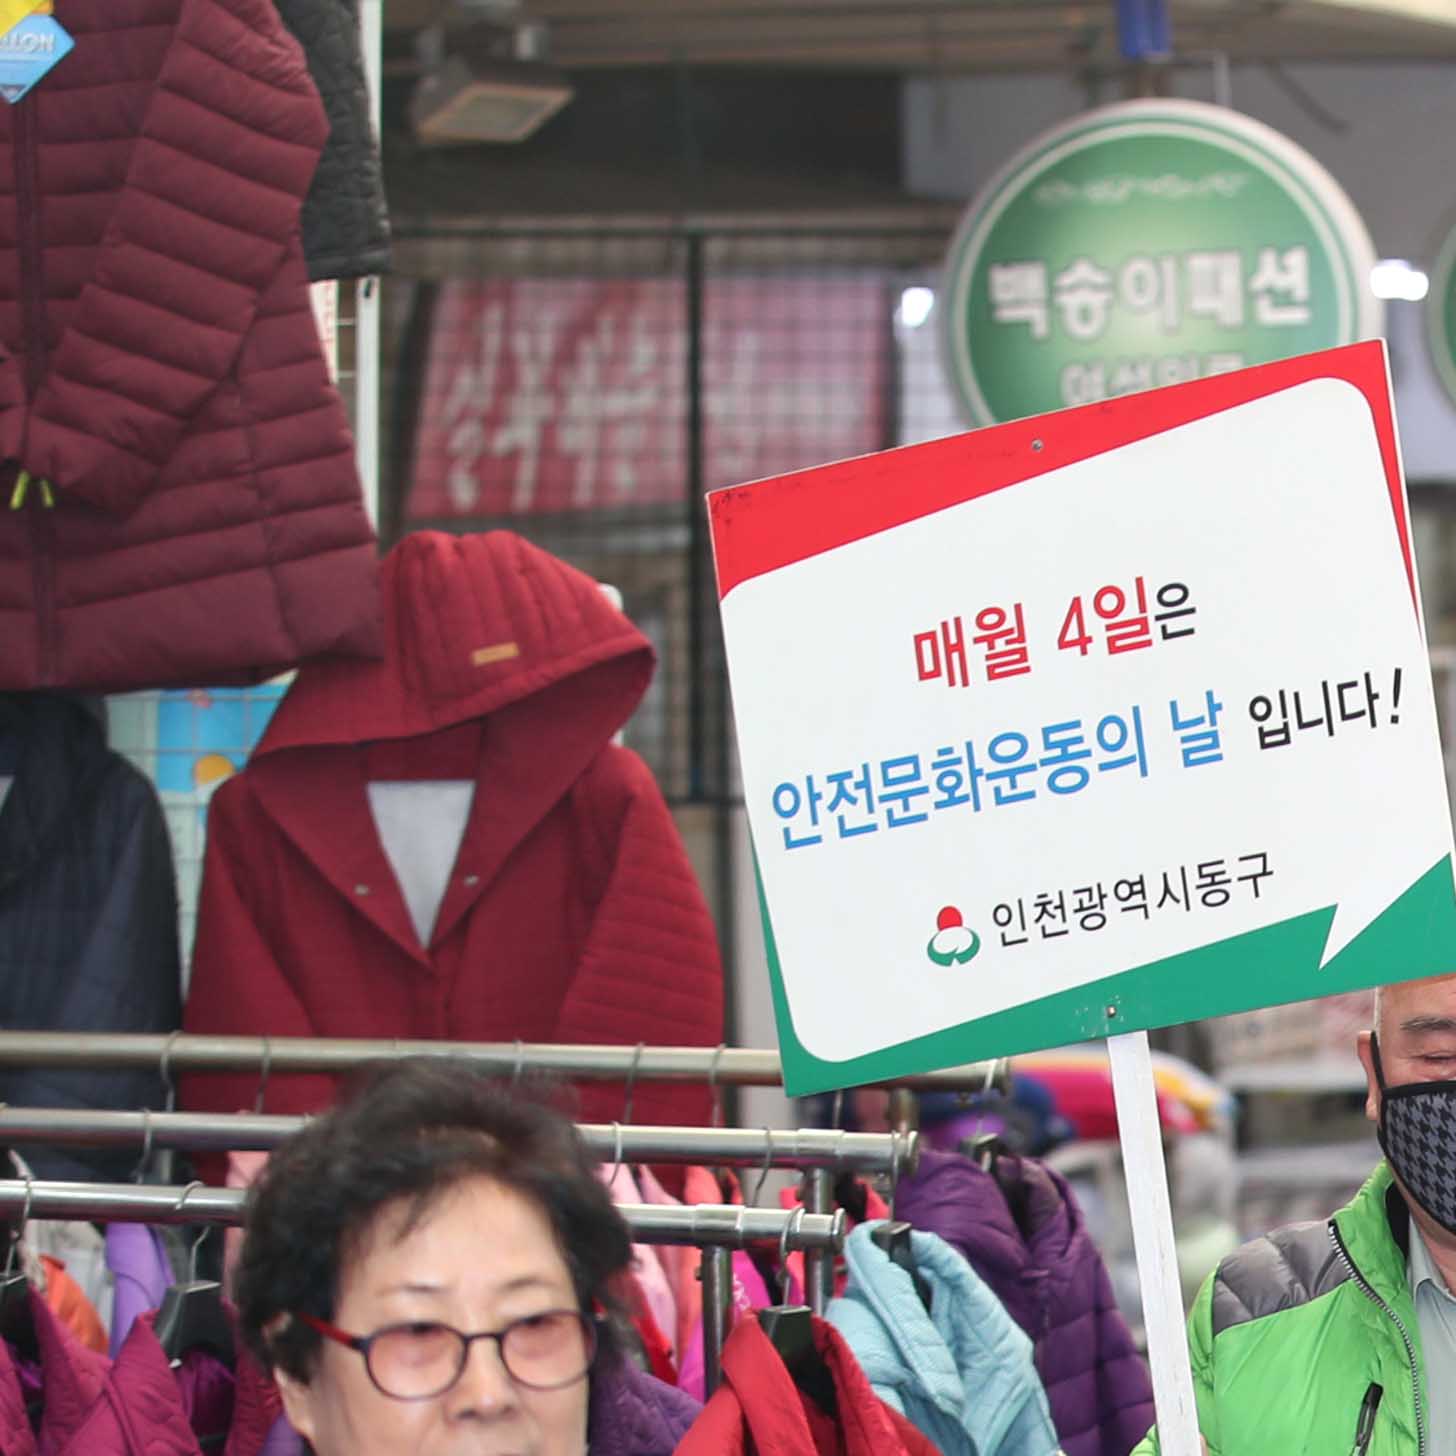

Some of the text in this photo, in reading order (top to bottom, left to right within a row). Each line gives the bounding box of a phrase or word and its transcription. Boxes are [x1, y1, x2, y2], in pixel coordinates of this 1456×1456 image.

[913, 575, 1197, 688] 매월 4일은
[772, 667, 1403, 850] 안전문화운동의 날 입니다!
[991, 851, 1275, 948] 인천광역시동구
